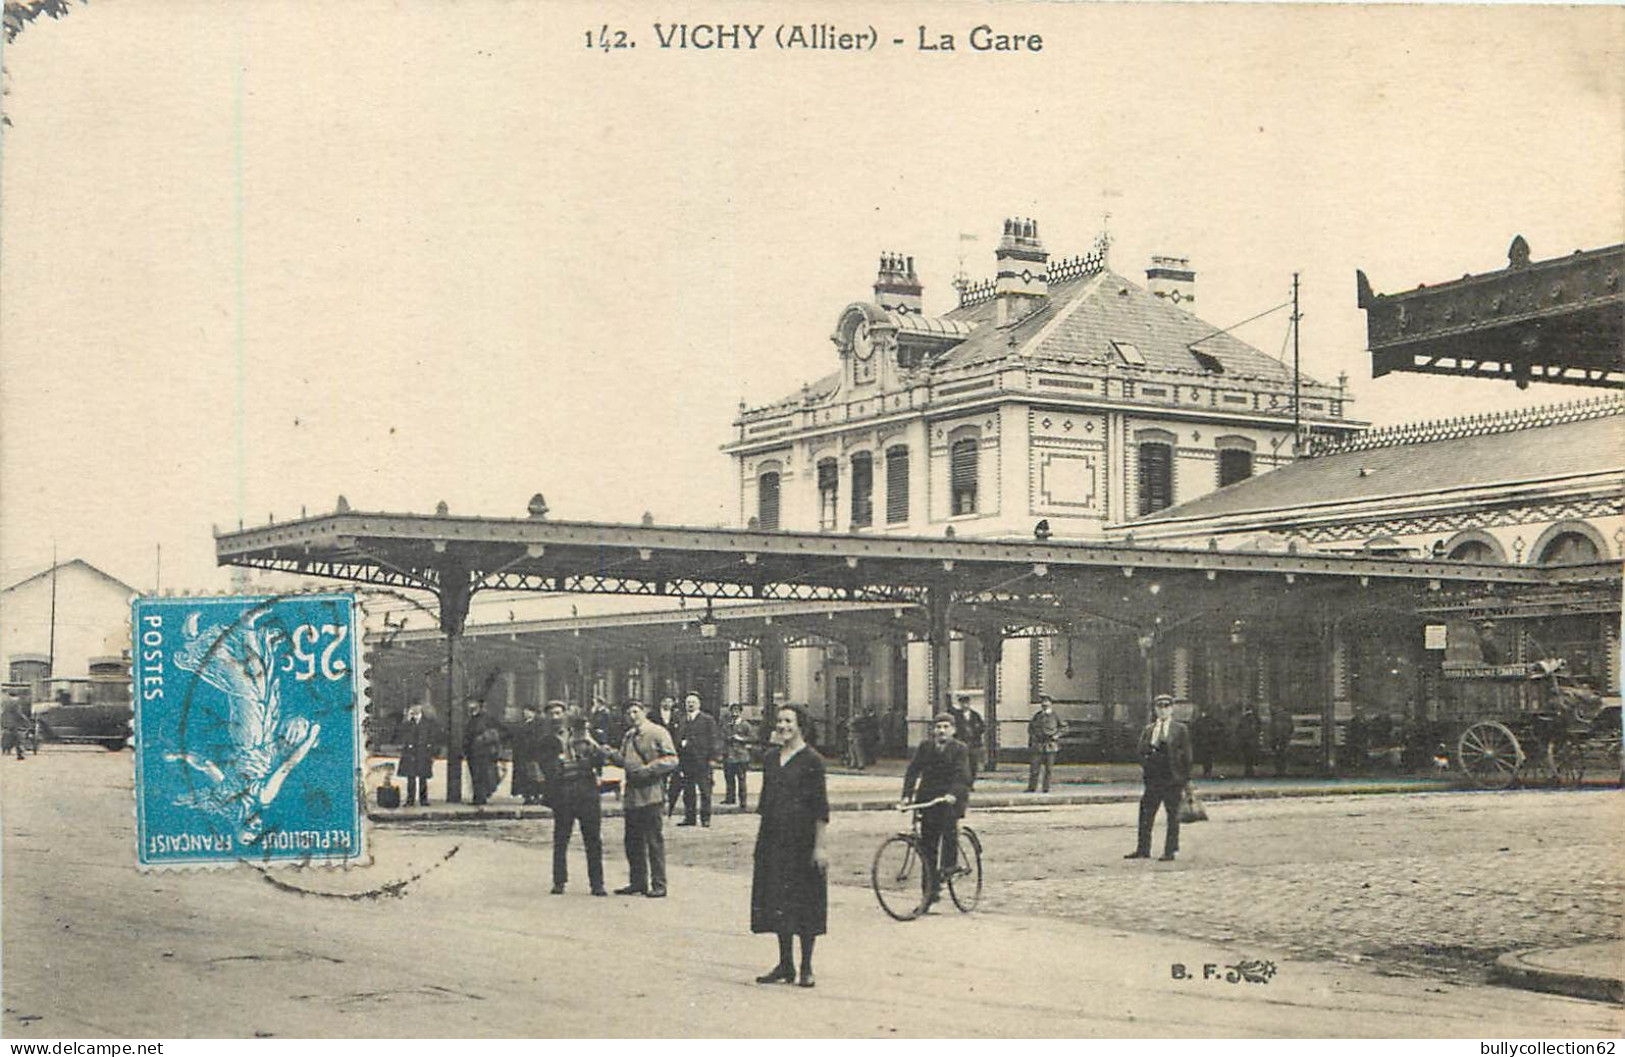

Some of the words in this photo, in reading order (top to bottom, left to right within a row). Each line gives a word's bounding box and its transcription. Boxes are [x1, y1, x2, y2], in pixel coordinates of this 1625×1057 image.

[585, 25, 636, 52] 142.
[653, 24, 764, 50] VICHY
[775, 24, 878, 50] (Allier)
[918, 26, 956, 51] La
[969, 25, 1043, 52] Gare
[143, 615, 164, 700] POSTES
